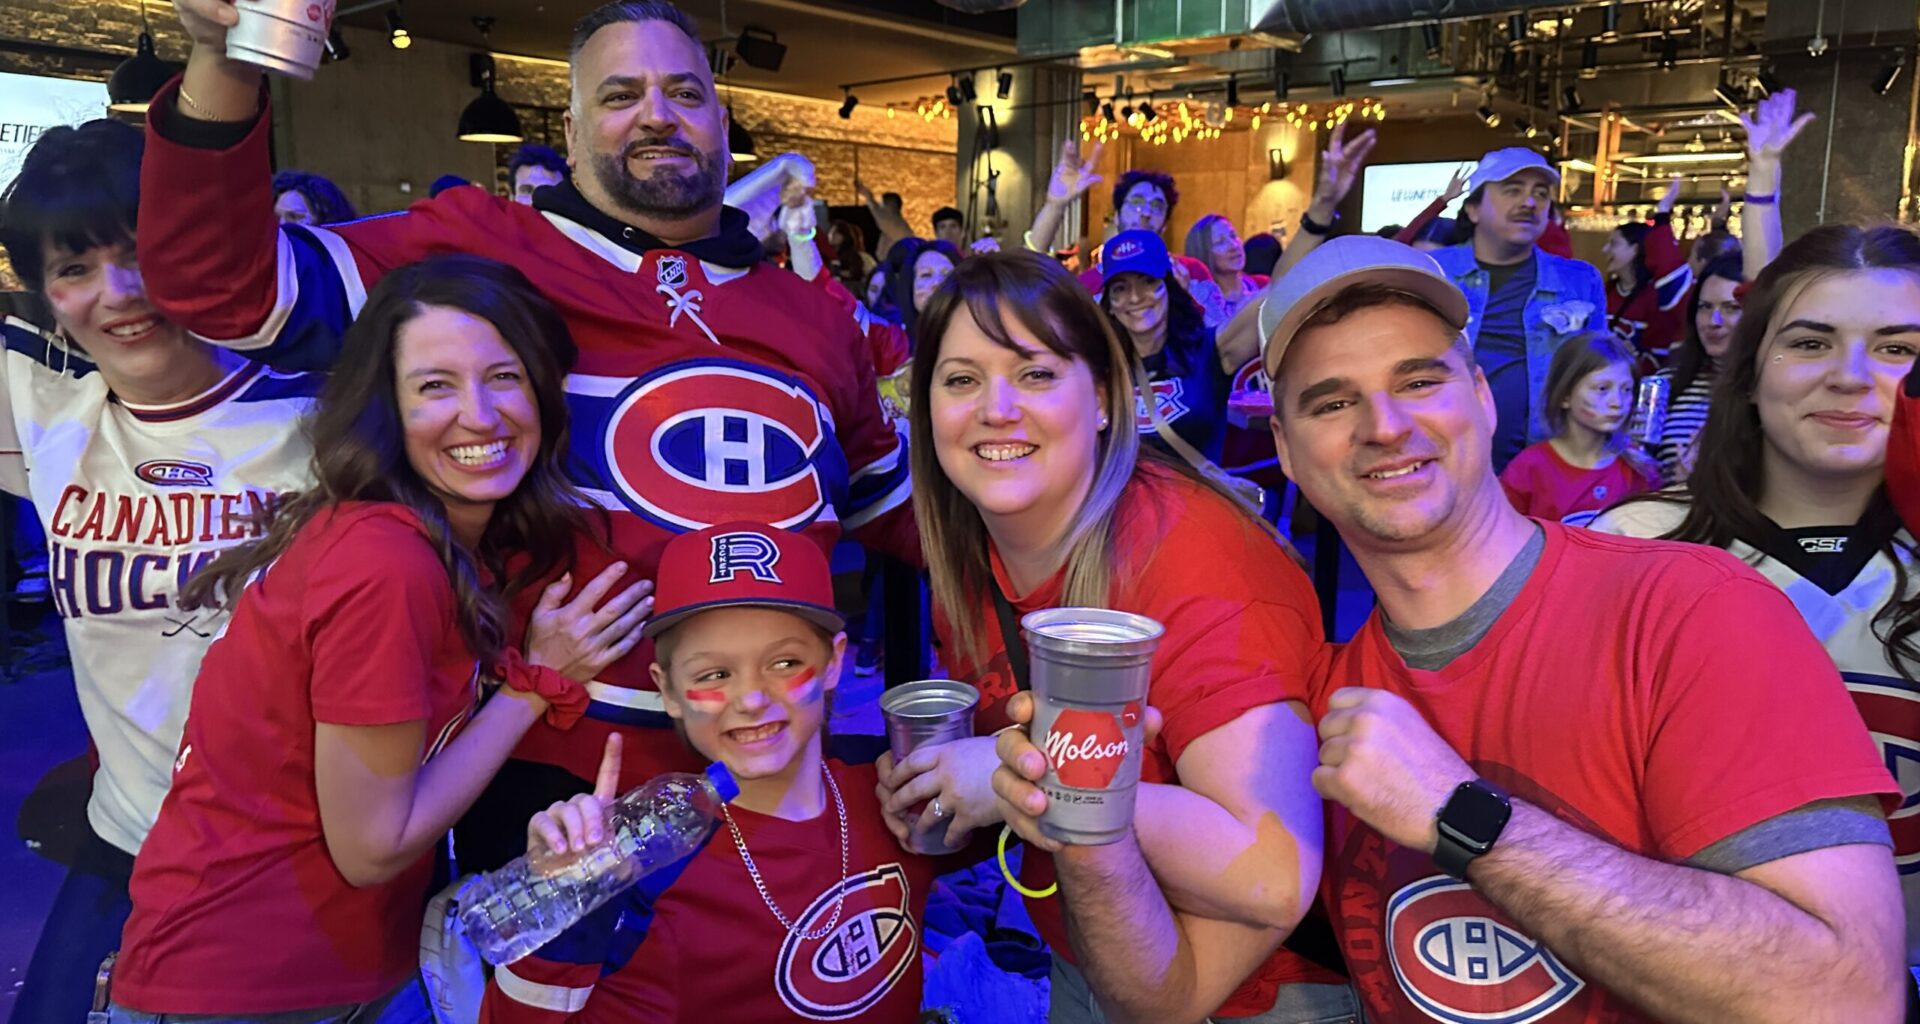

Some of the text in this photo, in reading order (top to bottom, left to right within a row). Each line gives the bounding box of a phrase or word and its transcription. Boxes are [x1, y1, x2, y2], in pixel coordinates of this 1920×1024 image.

[0, 122, 48, 143] ETIE
[51, 484, 280, 546] CANADIEN
[52, 541, 221, 618] HOCK
[718, 538, 727, 576] ROCKET
[1045, 730, 1128, 769] Molson
[1341, 835, 1393, 1014] MONT
